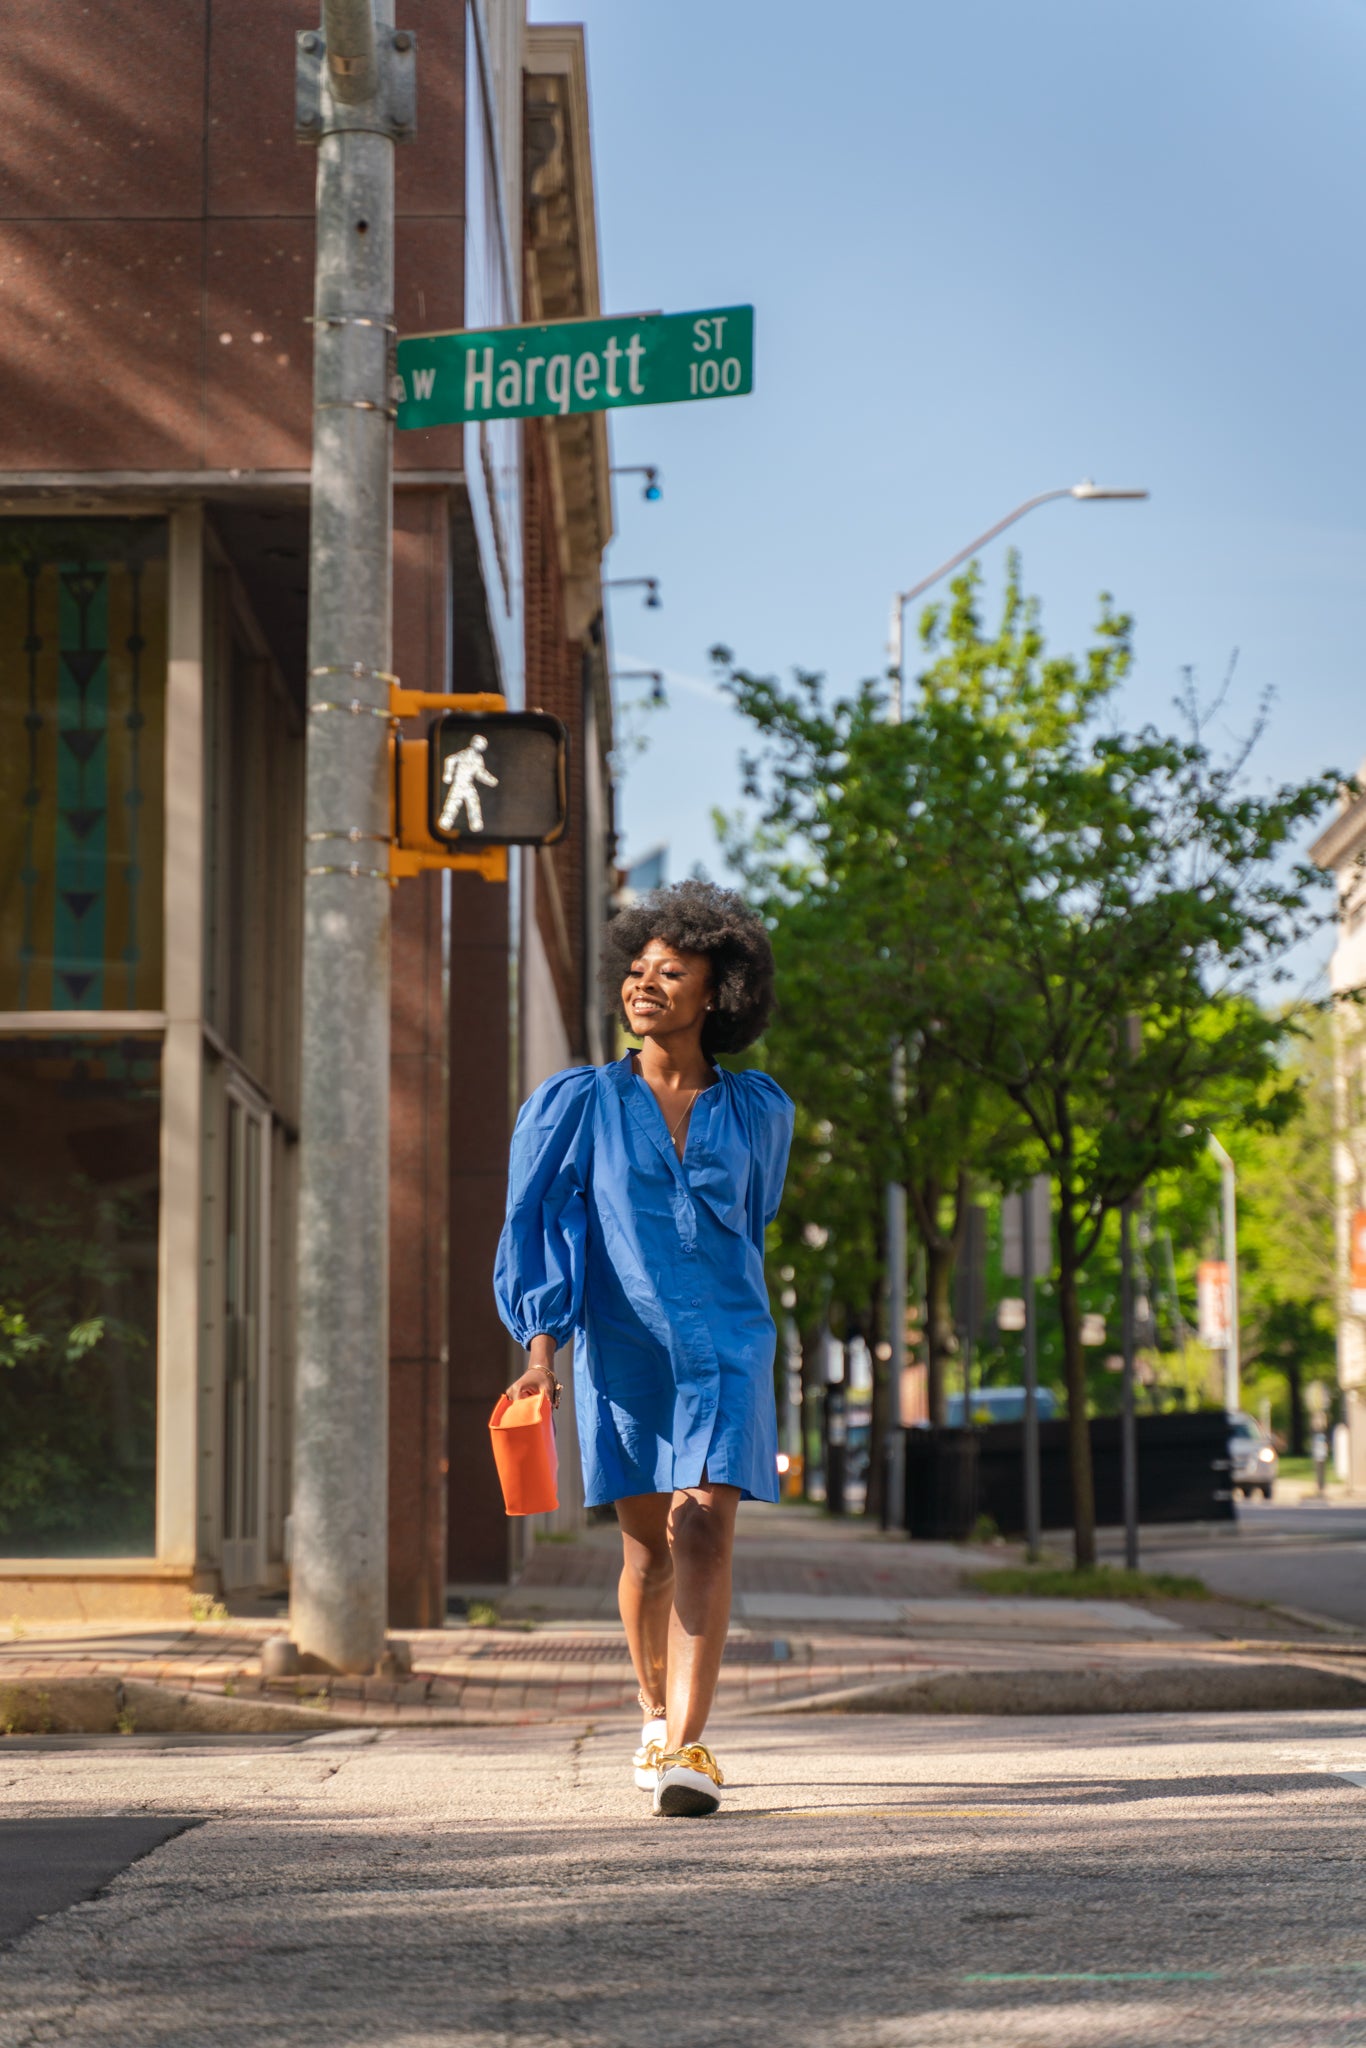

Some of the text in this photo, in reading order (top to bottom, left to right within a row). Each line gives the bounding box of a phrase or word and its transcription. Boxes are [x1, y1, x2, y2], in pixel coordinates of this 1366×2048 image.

[693, 317, 728, 352] ST
[412, 368, 436, 400] W
[689, 357, 742, 395] 100
